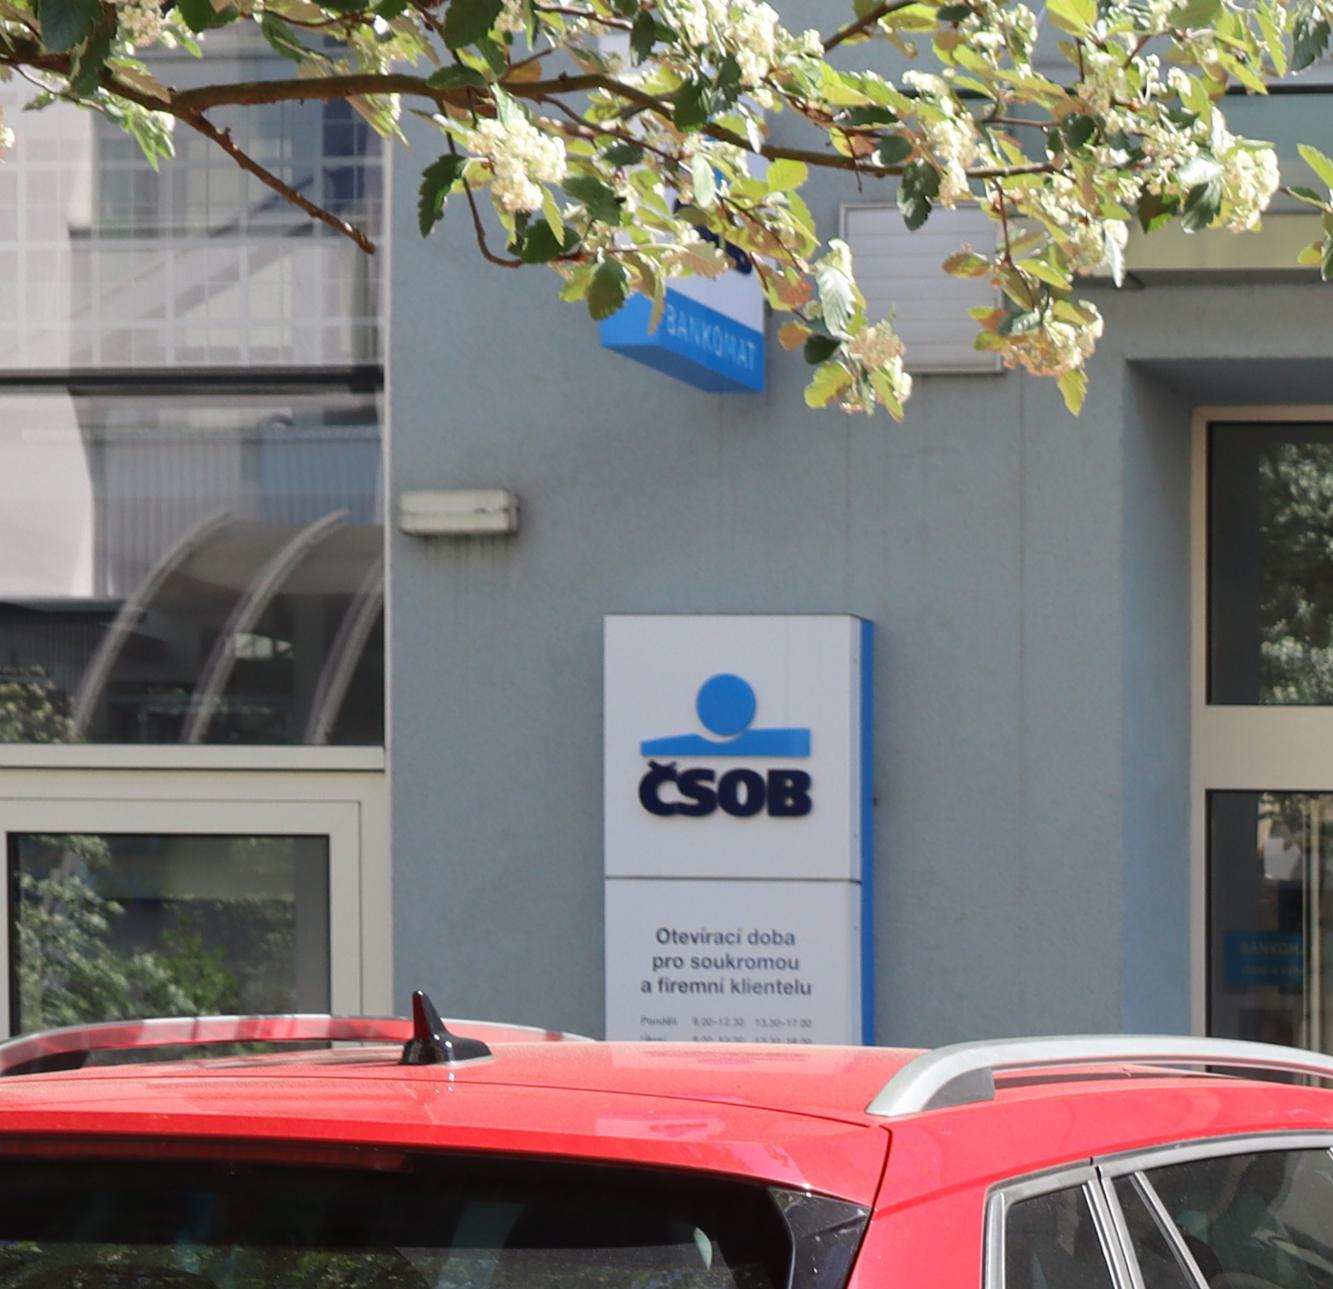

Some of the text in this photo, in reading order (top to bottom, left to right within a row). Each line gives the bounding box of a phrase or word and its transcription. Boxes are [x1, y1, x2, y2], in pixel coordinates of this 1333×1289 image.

[666, 303, 756, 371] BANKOMAT
[639, 761, 812, 817] ČSOB
[747, 929, 796, 945] doba
[652, 953, 800, 971] pro soukromou
[641, 977, 812, 995] a firemní klientelu
